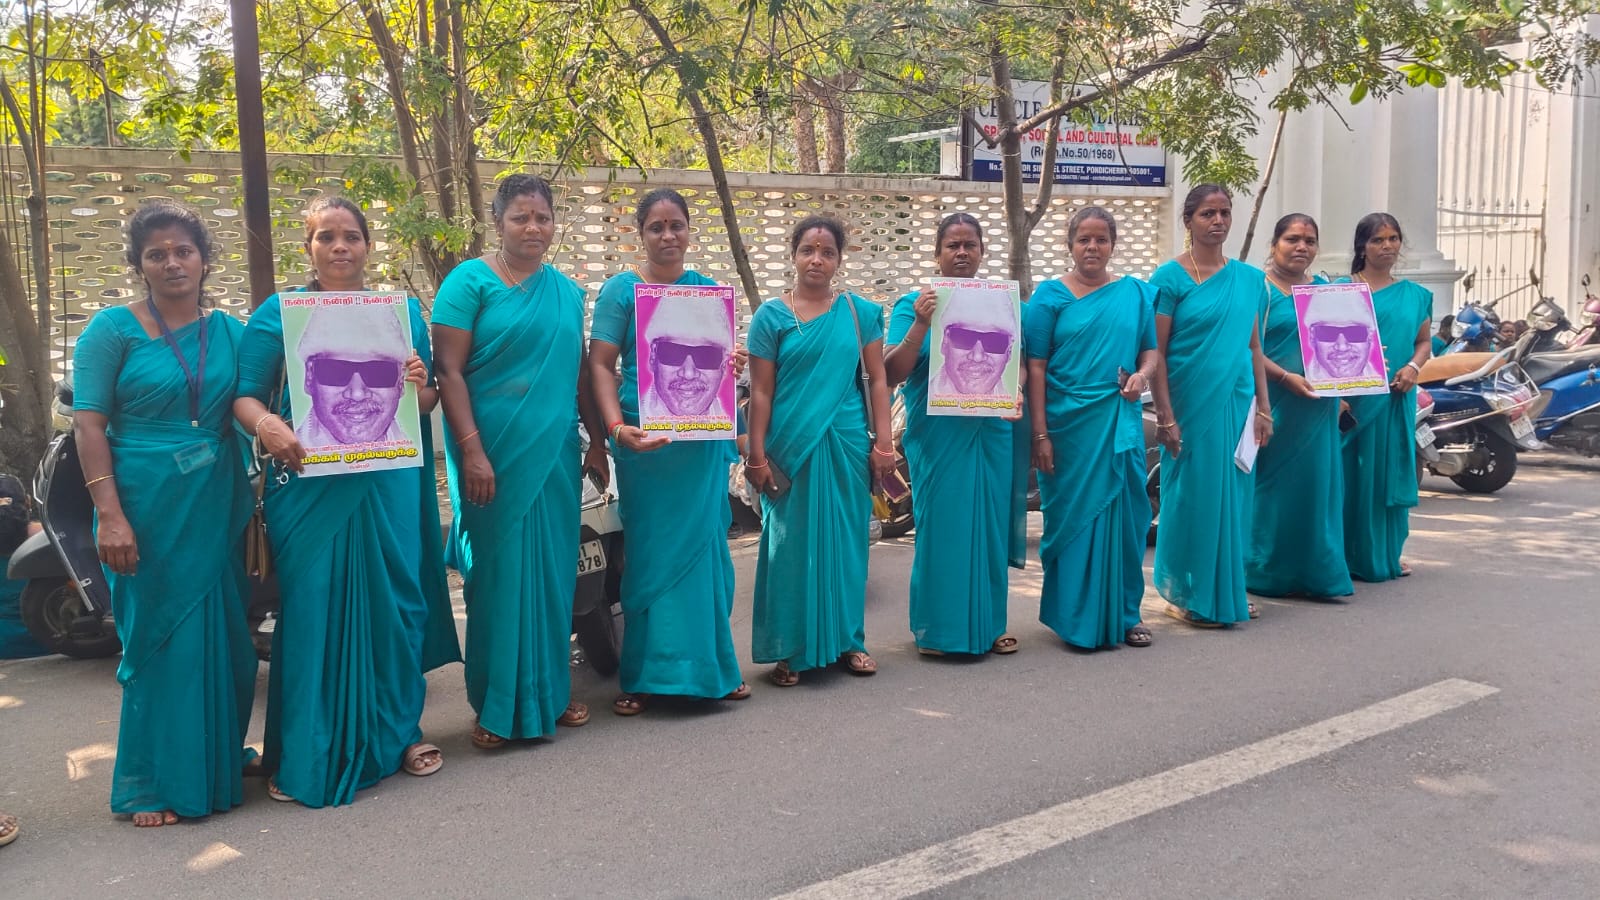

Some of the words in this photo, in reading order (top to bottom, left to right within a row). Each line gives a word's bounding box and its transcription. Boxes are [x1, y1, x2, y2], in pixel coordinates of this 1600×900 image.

[1066, 130, 1084, 143] AND
[1088, 131, 1133, 145] CULTURAL
[1136, 132, 1158, 146] CLUB
[1061, 166, 1085, 174] STREET,
[284, 296, 316, 306] நன்றி
[323, 295, 353, 306] நன்றி
[363, 295, 392, 305] நன்றி
[643, 422, 673, 431] மக்கள்
[675, 422, 732, 432] முதல்வருக்கு
[301, 453, 341, 464] மக்கள்
[344, 447, 418, 463] முதல்வருக்கு
